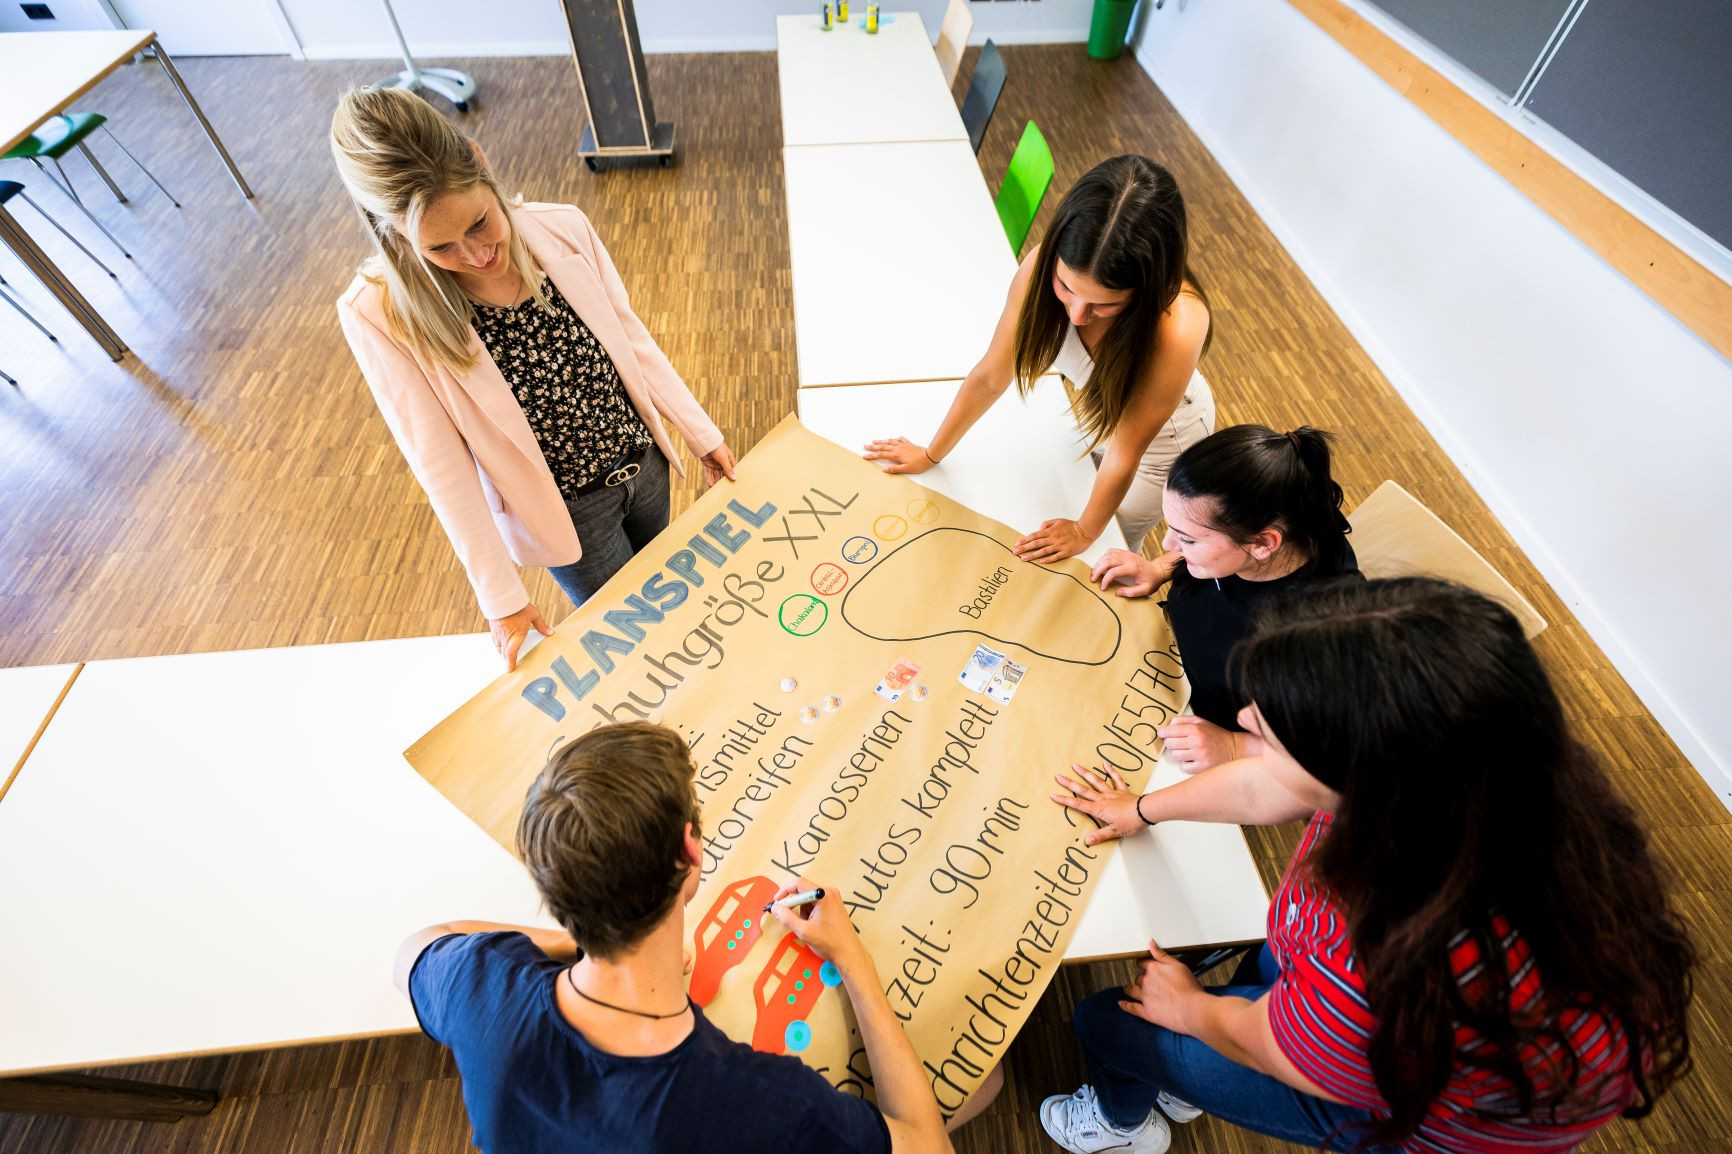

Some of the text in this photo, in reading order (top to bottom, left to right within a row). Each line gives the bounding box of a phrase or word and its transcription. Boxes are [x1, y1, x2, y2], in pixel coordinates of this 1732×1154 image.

[520, 498, 778, 723] PLANSPIEL
[547, 487, 860, 762] huhgröße XXL
[958, 565, 1013, 620] Bastilien
[699, 735, 815, 884] utoreifen
[770, 709, 913, 877] Karosserien
[844, 698, 999, 934] Autos komplett
[922, 836, 1098, 1125] chrichtenzeiten:
